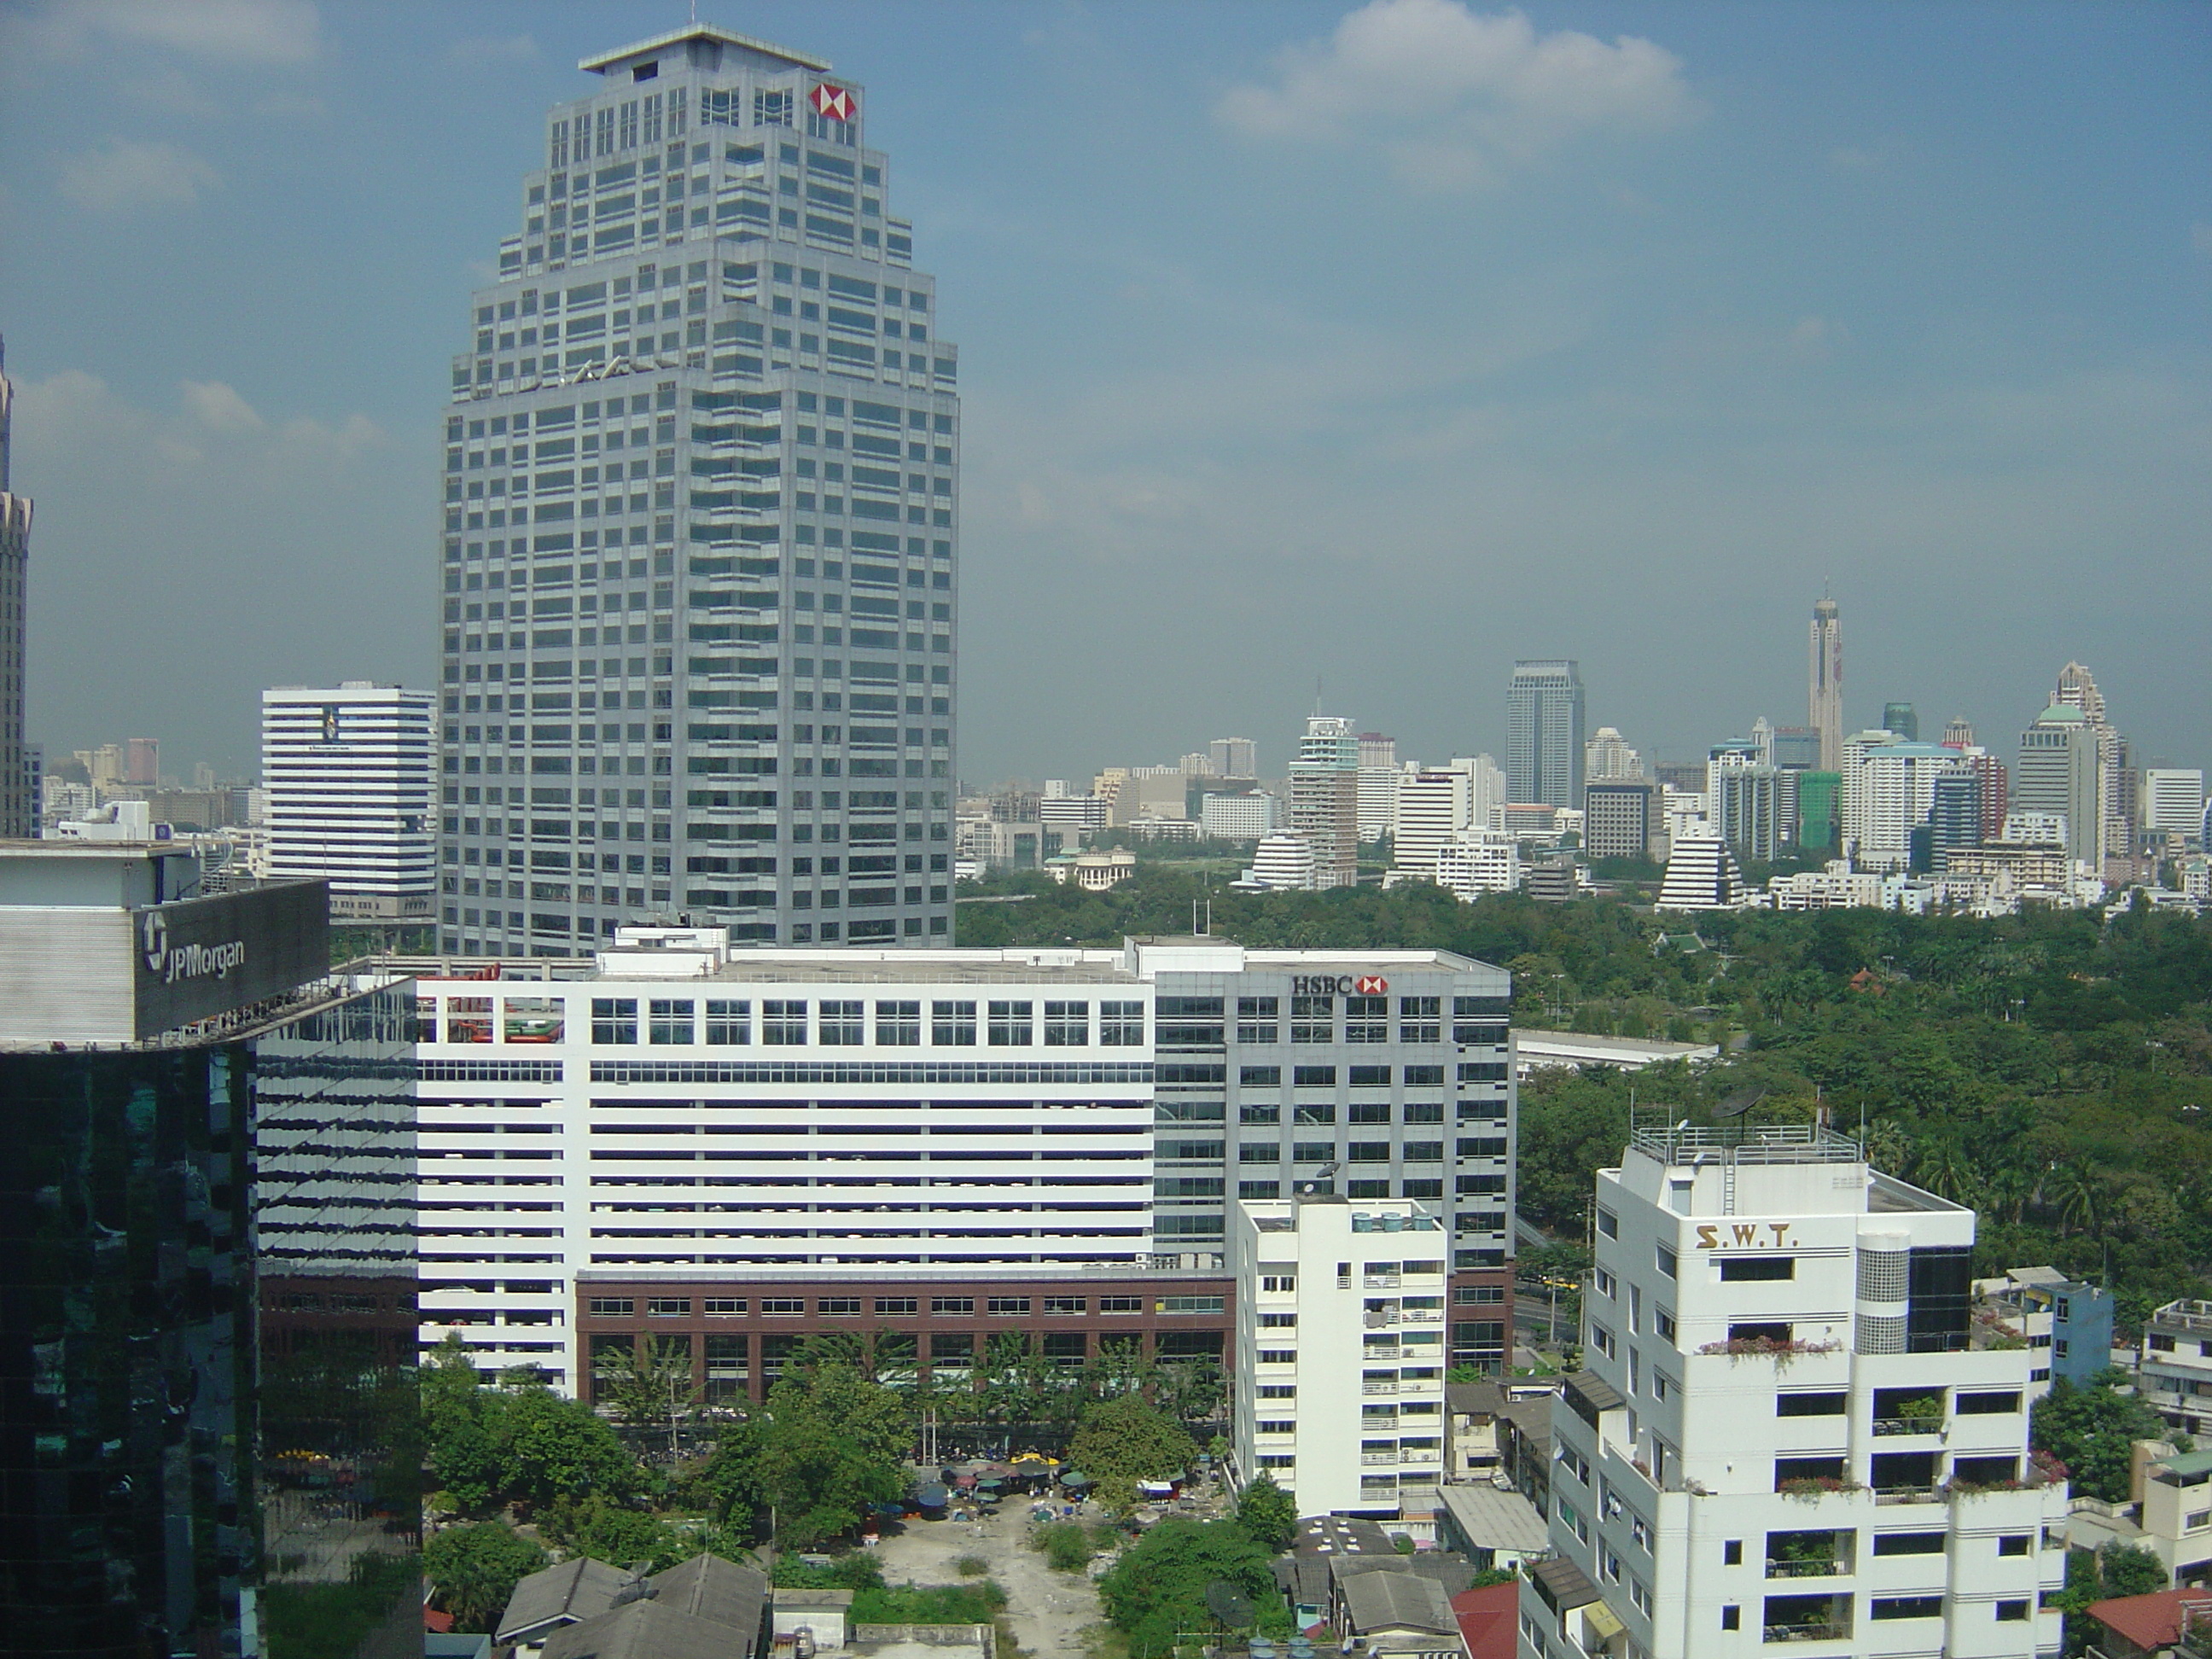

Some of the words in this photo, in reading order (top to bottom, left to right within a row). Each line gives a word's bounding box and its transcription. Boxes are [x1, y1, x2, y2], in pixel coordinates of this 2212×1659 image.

[166, 940, 245, 984] JPMorgan
[1292, 975, 1353, 995] HSBC
[1696, 1222, 1799, 1249] S.W.T.
